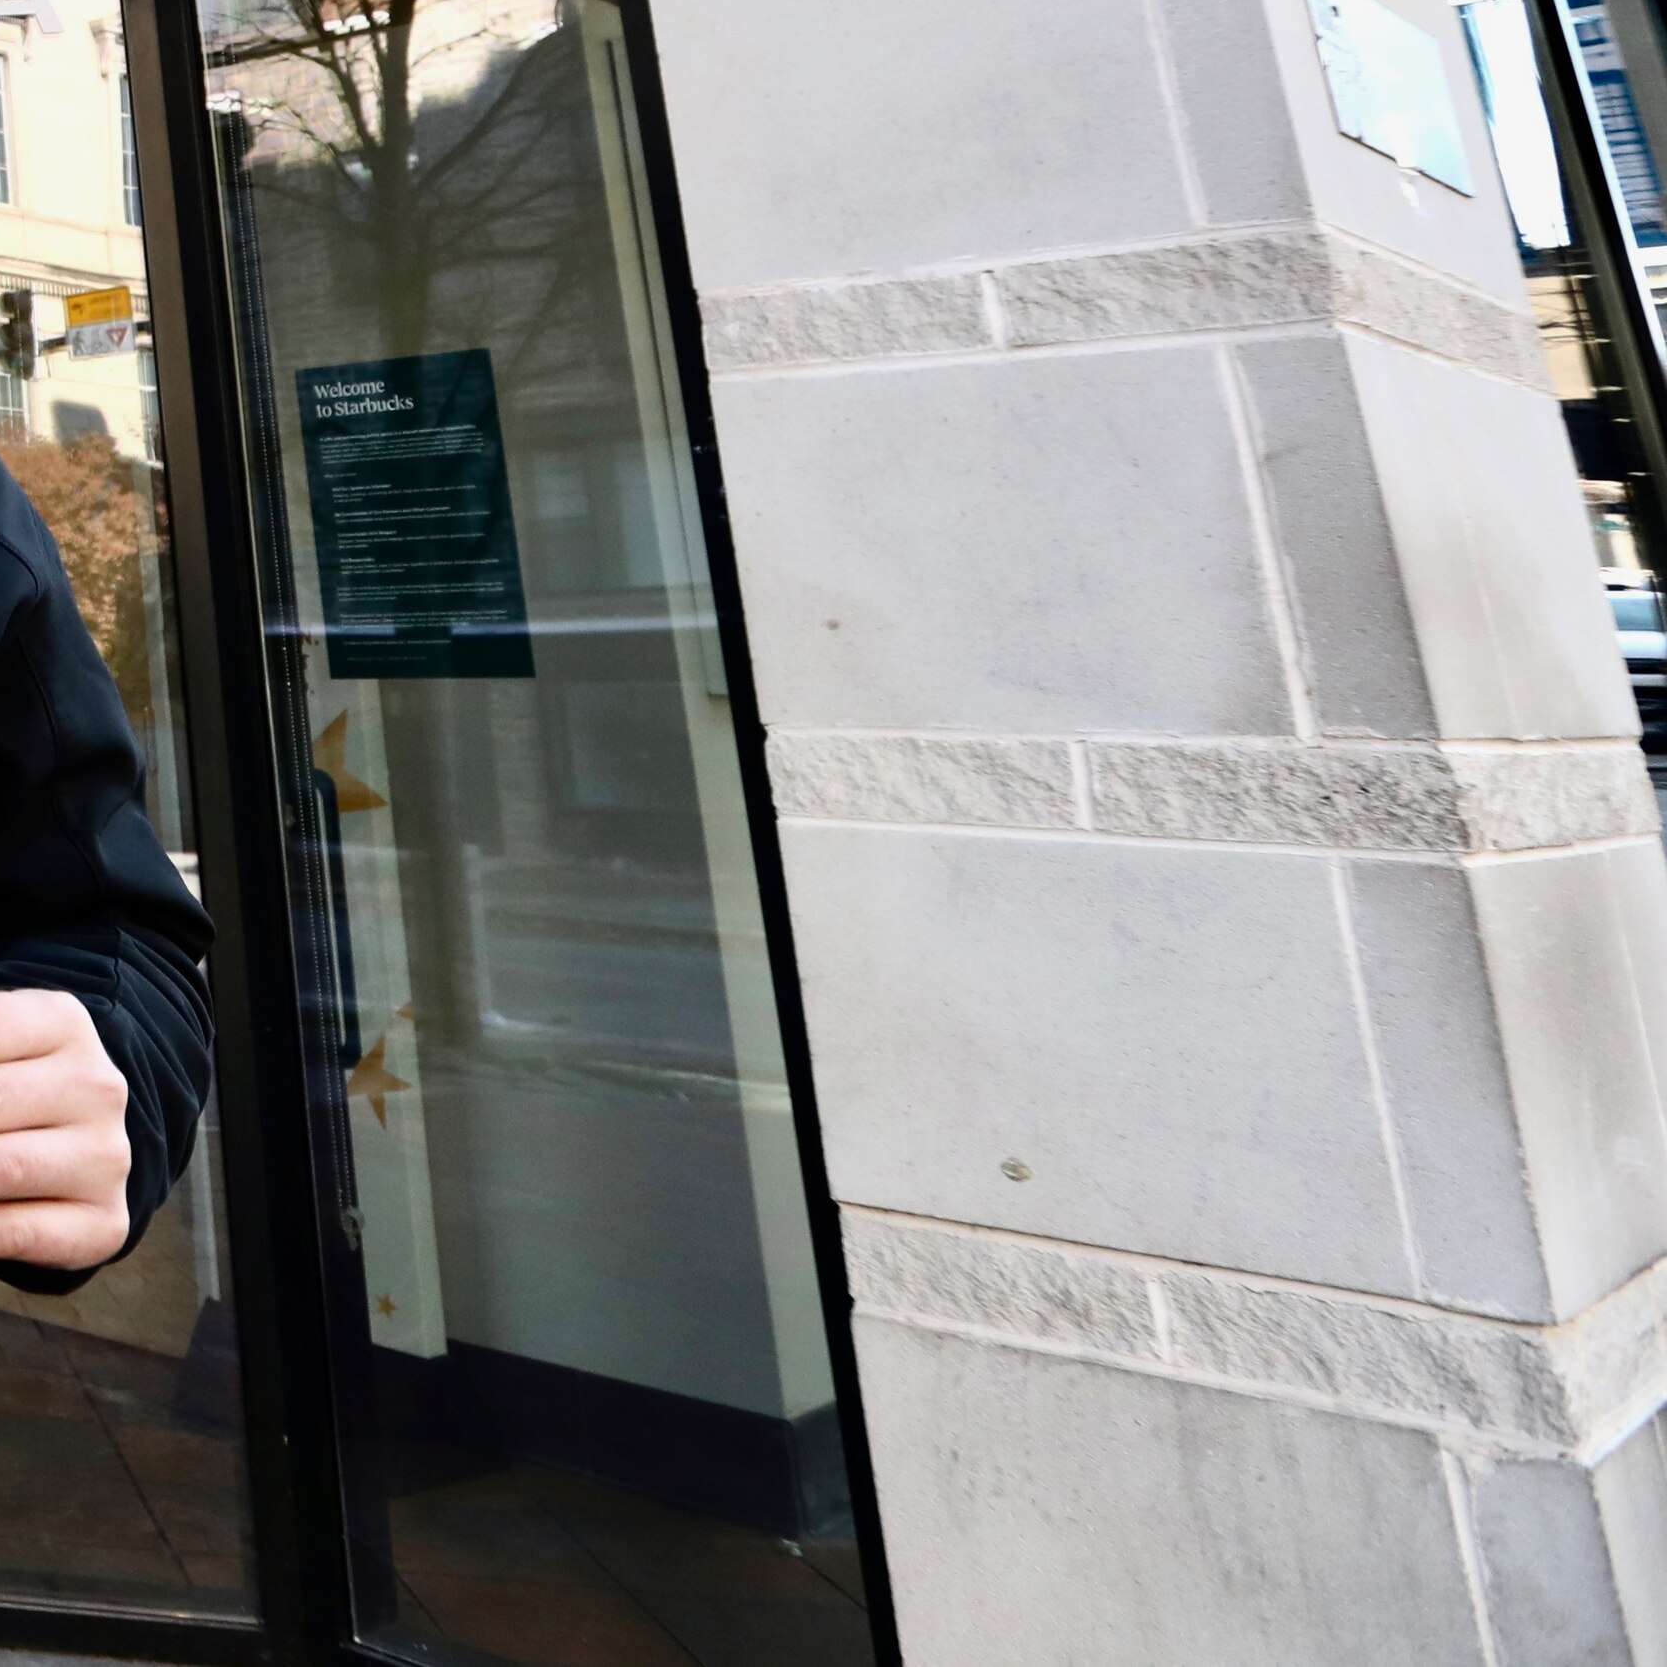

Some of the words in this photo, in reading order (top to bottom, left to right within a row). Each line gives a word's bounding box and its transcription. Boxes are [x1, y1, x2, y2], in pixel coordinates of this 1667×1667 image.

[313, 379, 386, 399] Welcome
[316, 404, 333, 419] to
[334, 394, 415, 417] Starbucks
